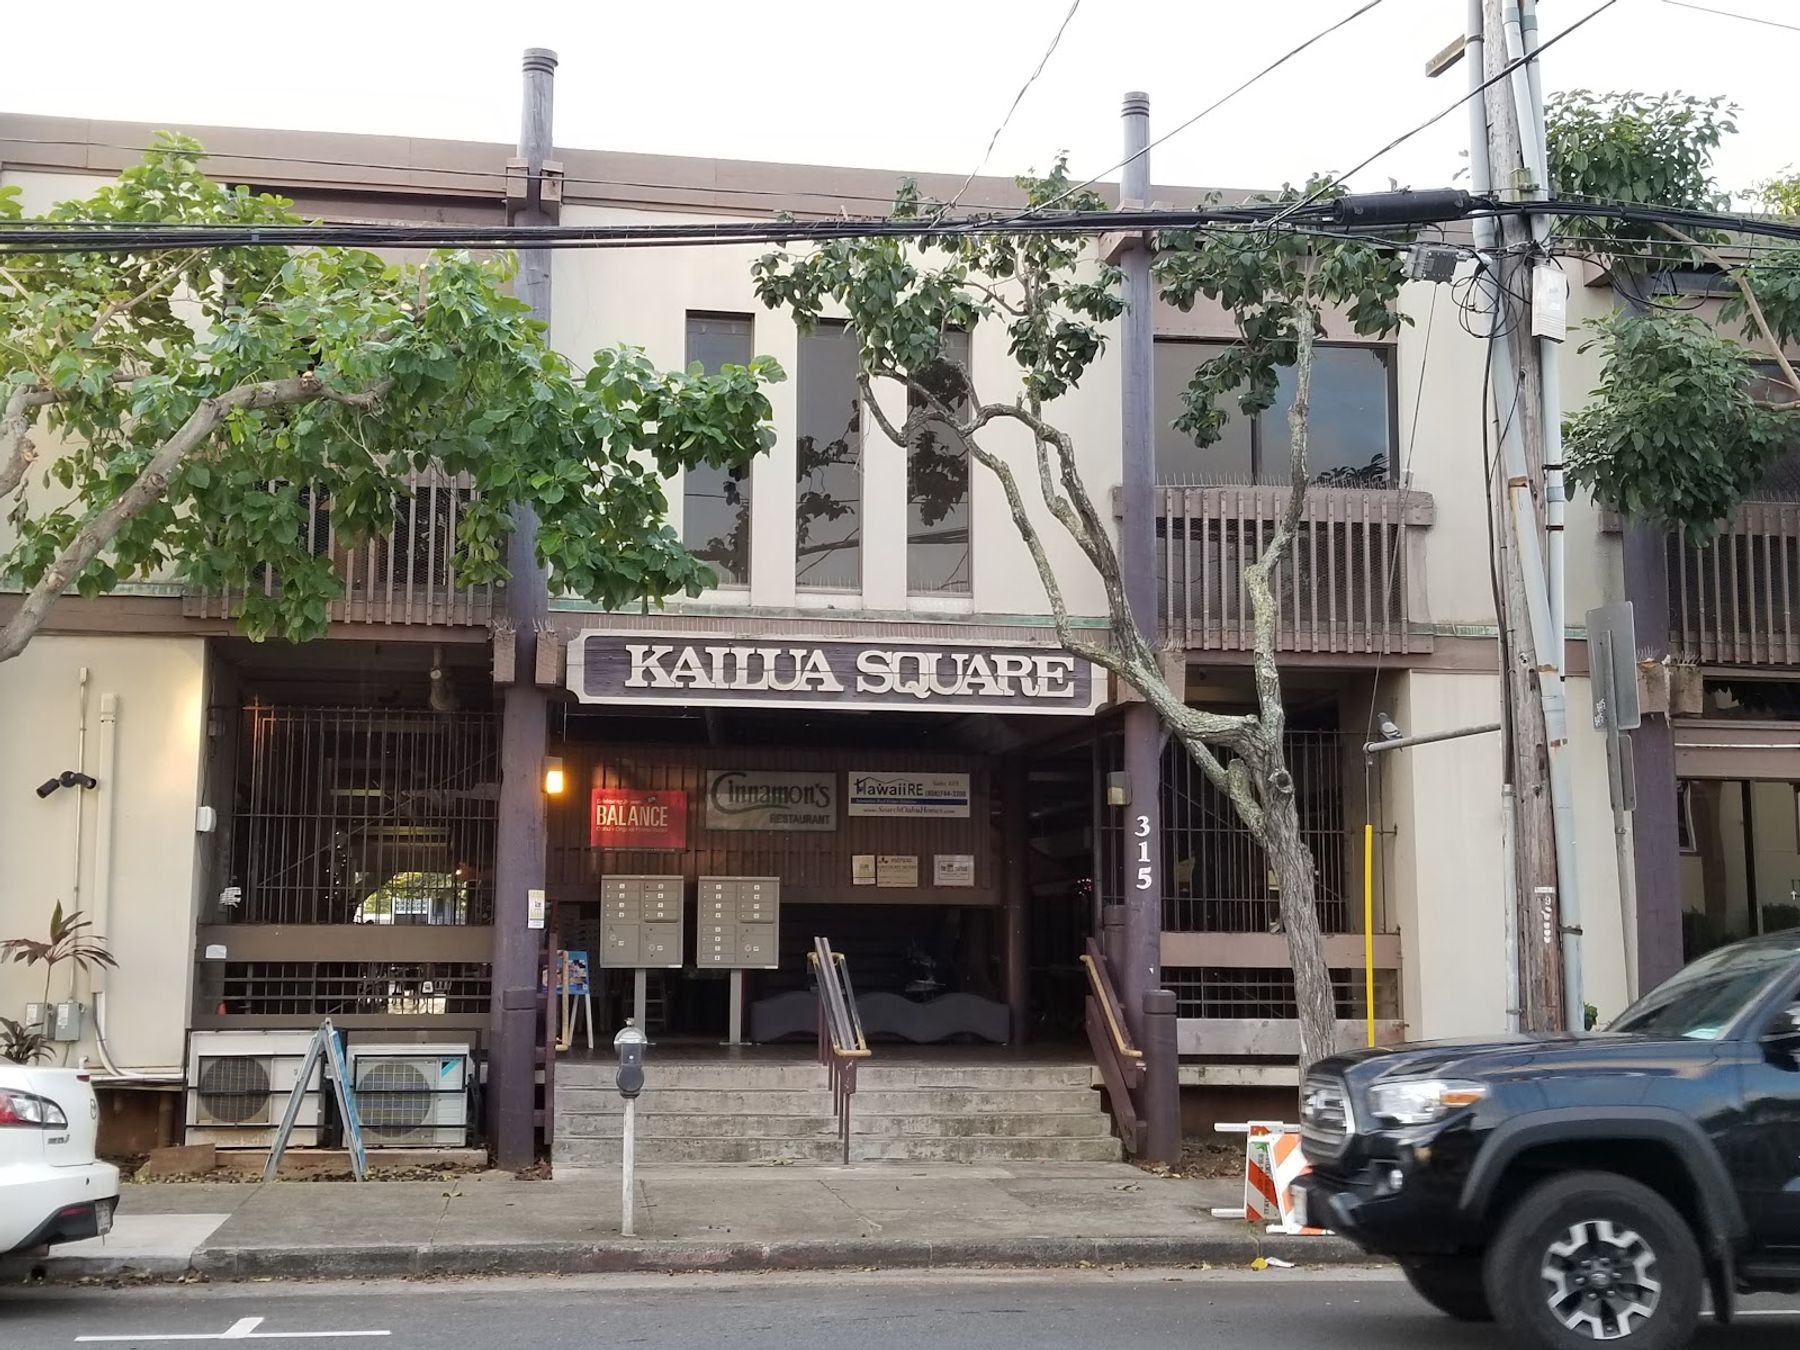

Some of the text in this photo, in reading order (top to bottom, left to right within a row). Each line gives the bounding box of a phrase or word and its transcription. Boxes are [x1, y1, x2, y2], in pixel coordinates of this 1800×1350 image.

[624, 644, 1075, 700] KAILUA SQUARE
[711, 771, 831, 815] Cinnamon's
[596, 804, 669, 827] BALANCE
[769, 814, 831, 825] RESTAURANT
[1134, 815, 1153, 890] 315
